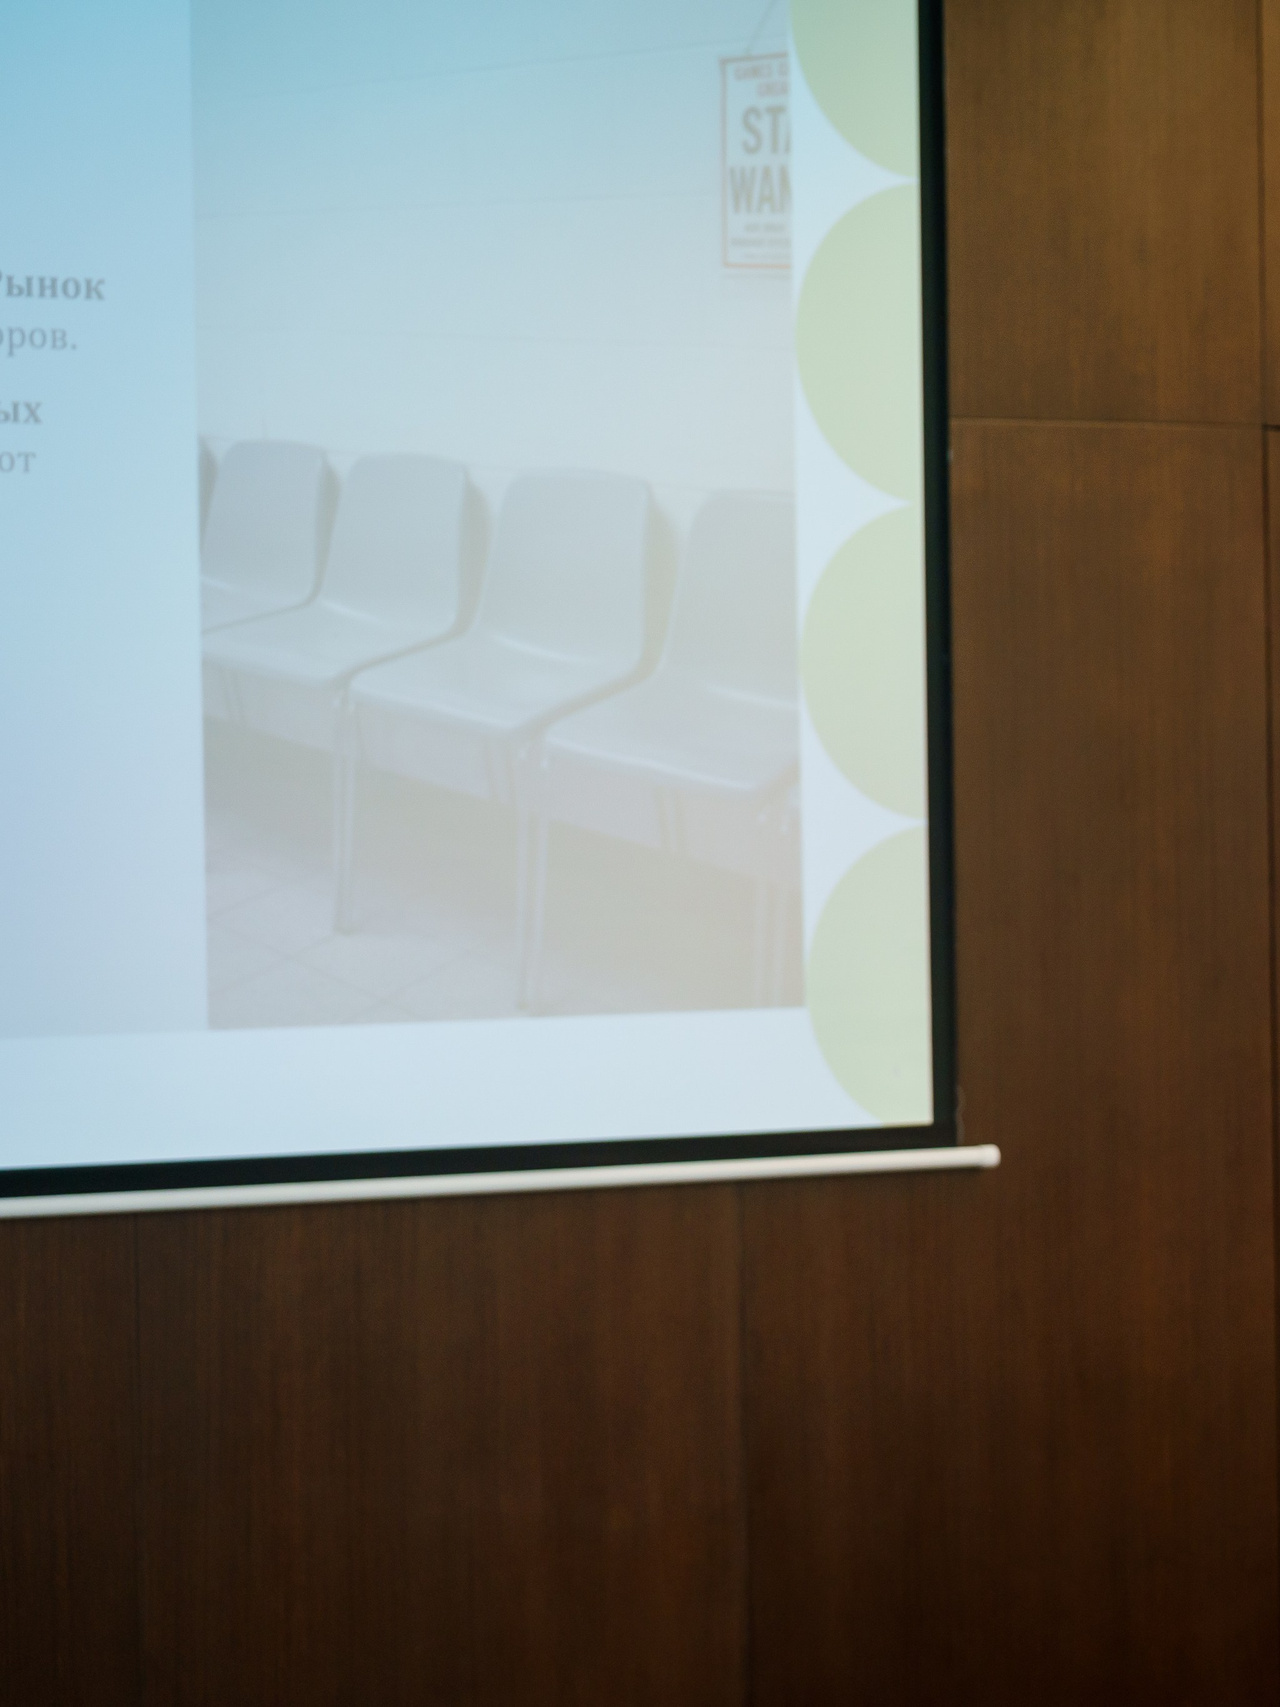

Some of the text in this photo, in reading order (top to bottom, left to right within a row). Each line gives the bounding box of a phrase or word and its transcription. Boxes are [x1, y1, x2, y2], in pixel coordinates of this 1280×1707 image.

[742, 106, 791, 154] ST
[0, 271, 105, 301] ынок
[0, 326, 77, 357] ров.
